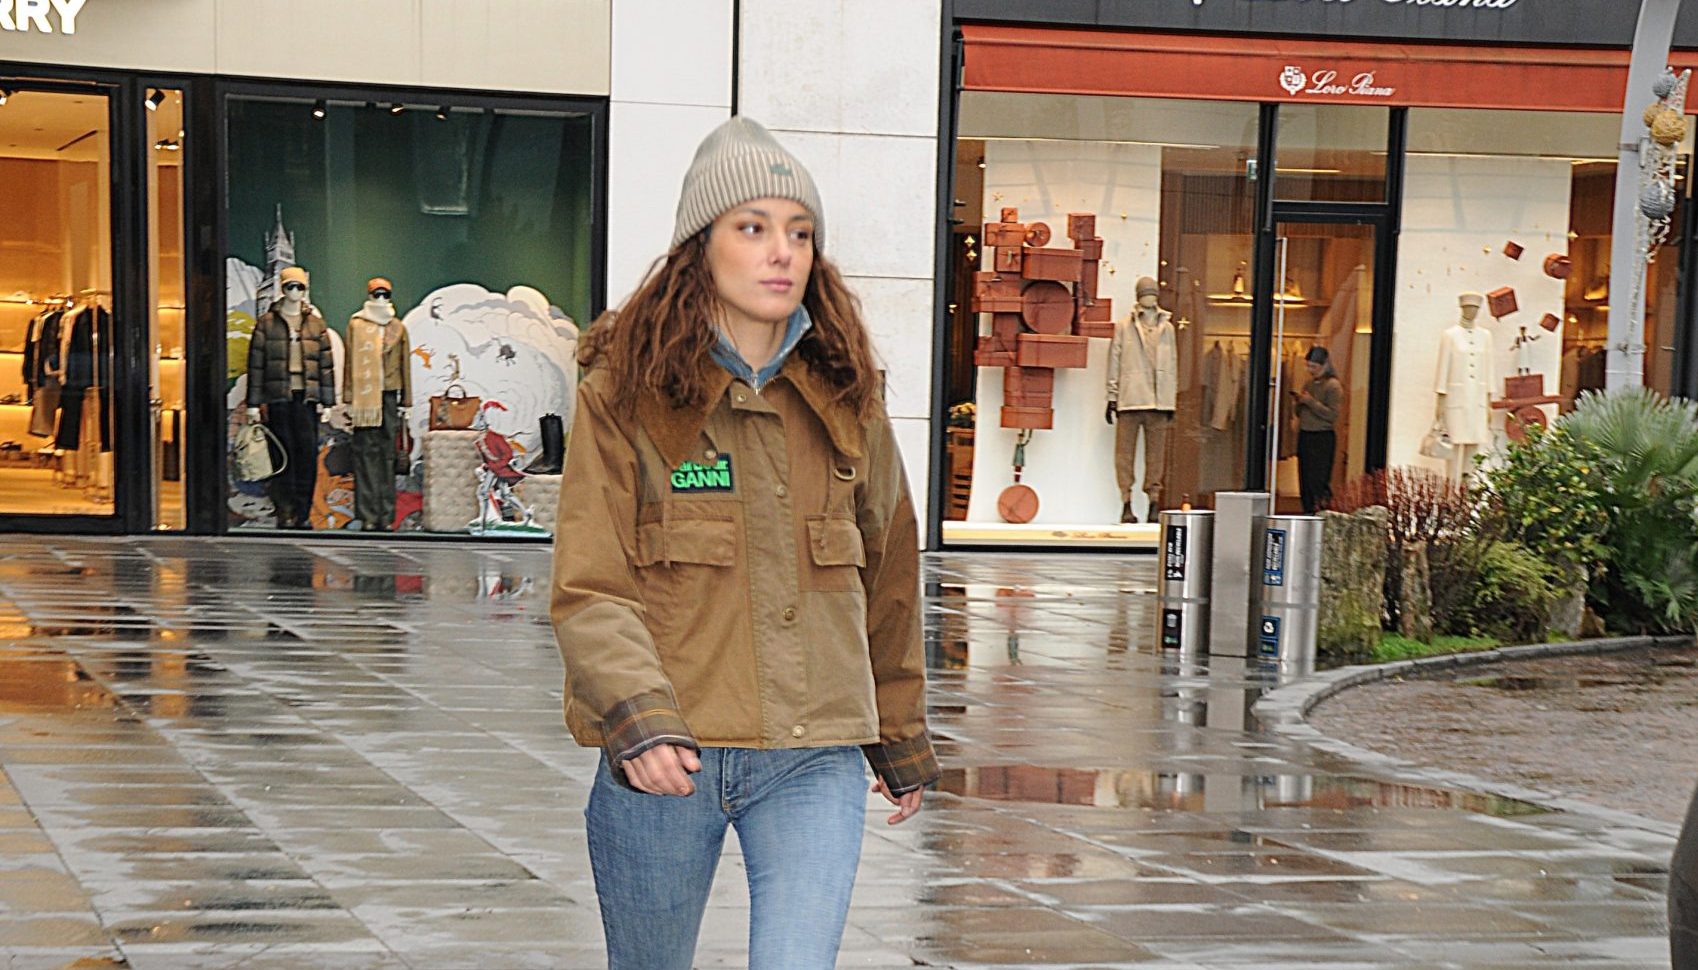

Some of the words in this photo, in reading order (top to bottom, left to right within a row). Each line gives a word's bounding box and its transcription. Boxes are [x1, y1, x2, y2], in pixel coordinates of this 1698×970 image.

[1305, 70, 1348, 94] Loro
[1349, 70, 1396, 96] Piana
[671, 471, 731, 488] GANNI
